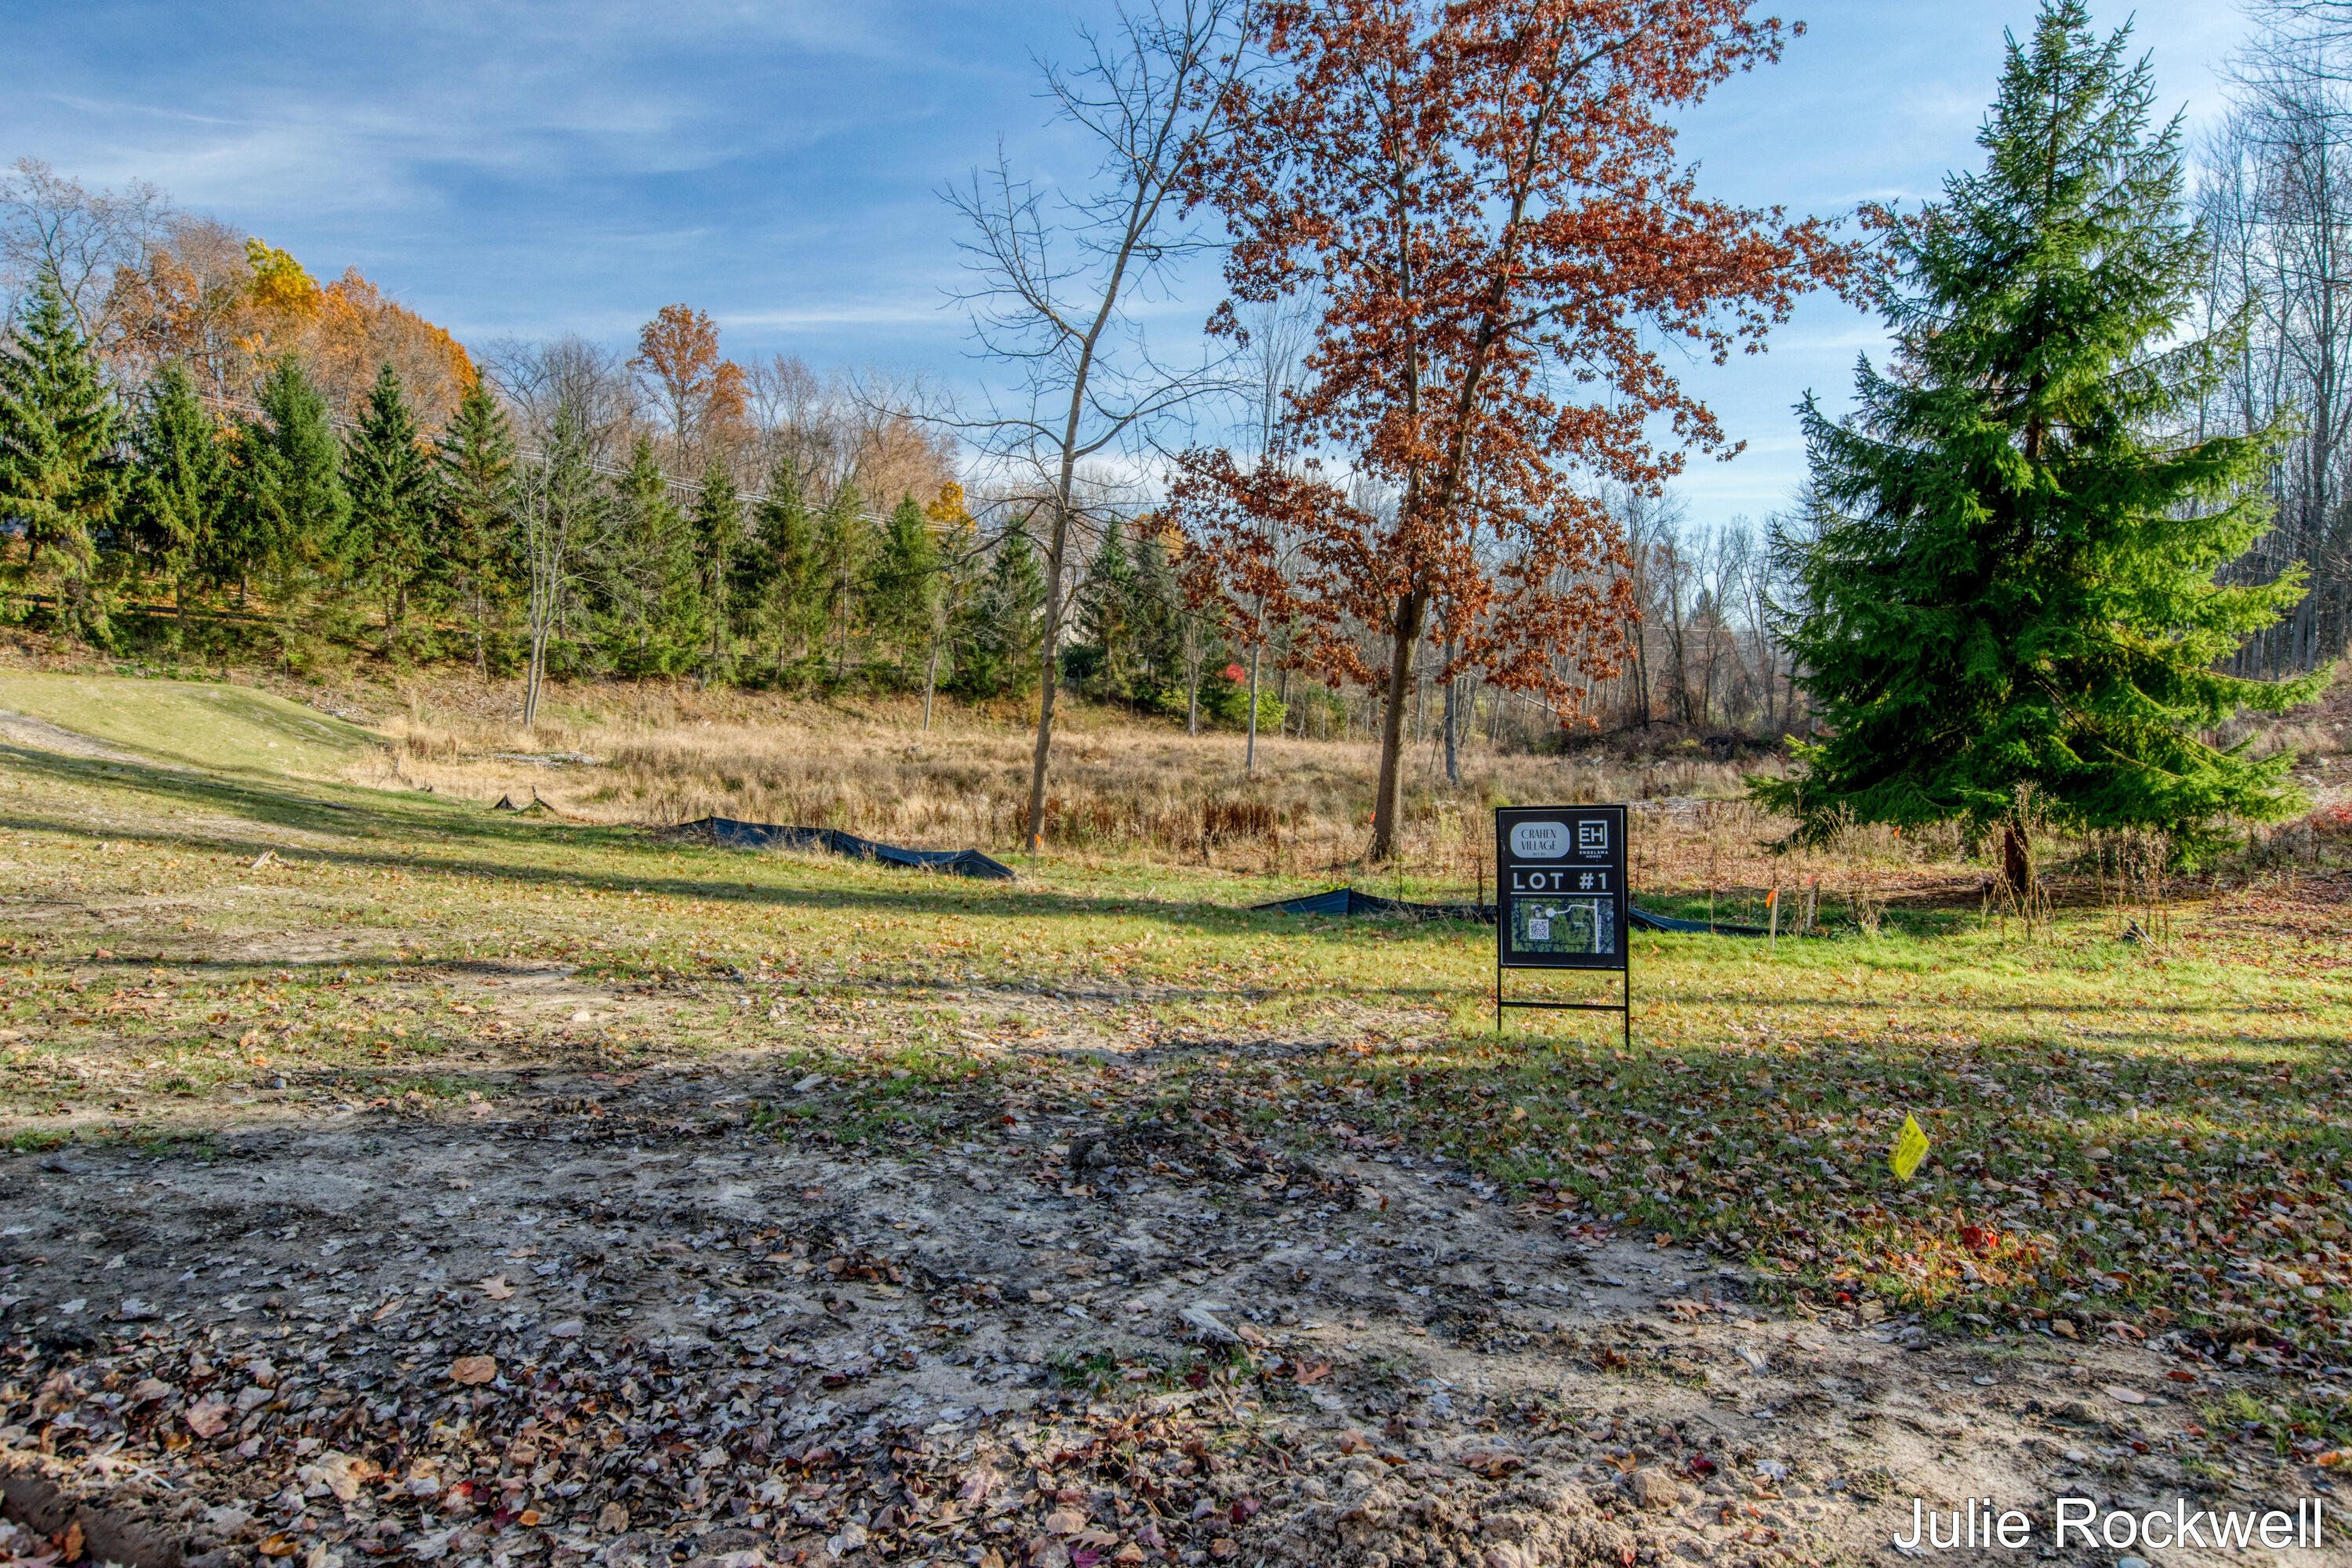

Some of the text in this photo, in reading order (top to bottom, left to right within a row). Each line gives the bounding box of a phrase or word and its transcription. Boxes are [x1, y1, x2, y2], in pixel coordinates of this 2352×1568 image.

[1521, 829, 1556, 839] CRAHEN
[1579, 827, 1603, 842] EH
[1521, 840, 1557, 851] VILLAGE
[1513, 872, 1607, 890] LOT #1
